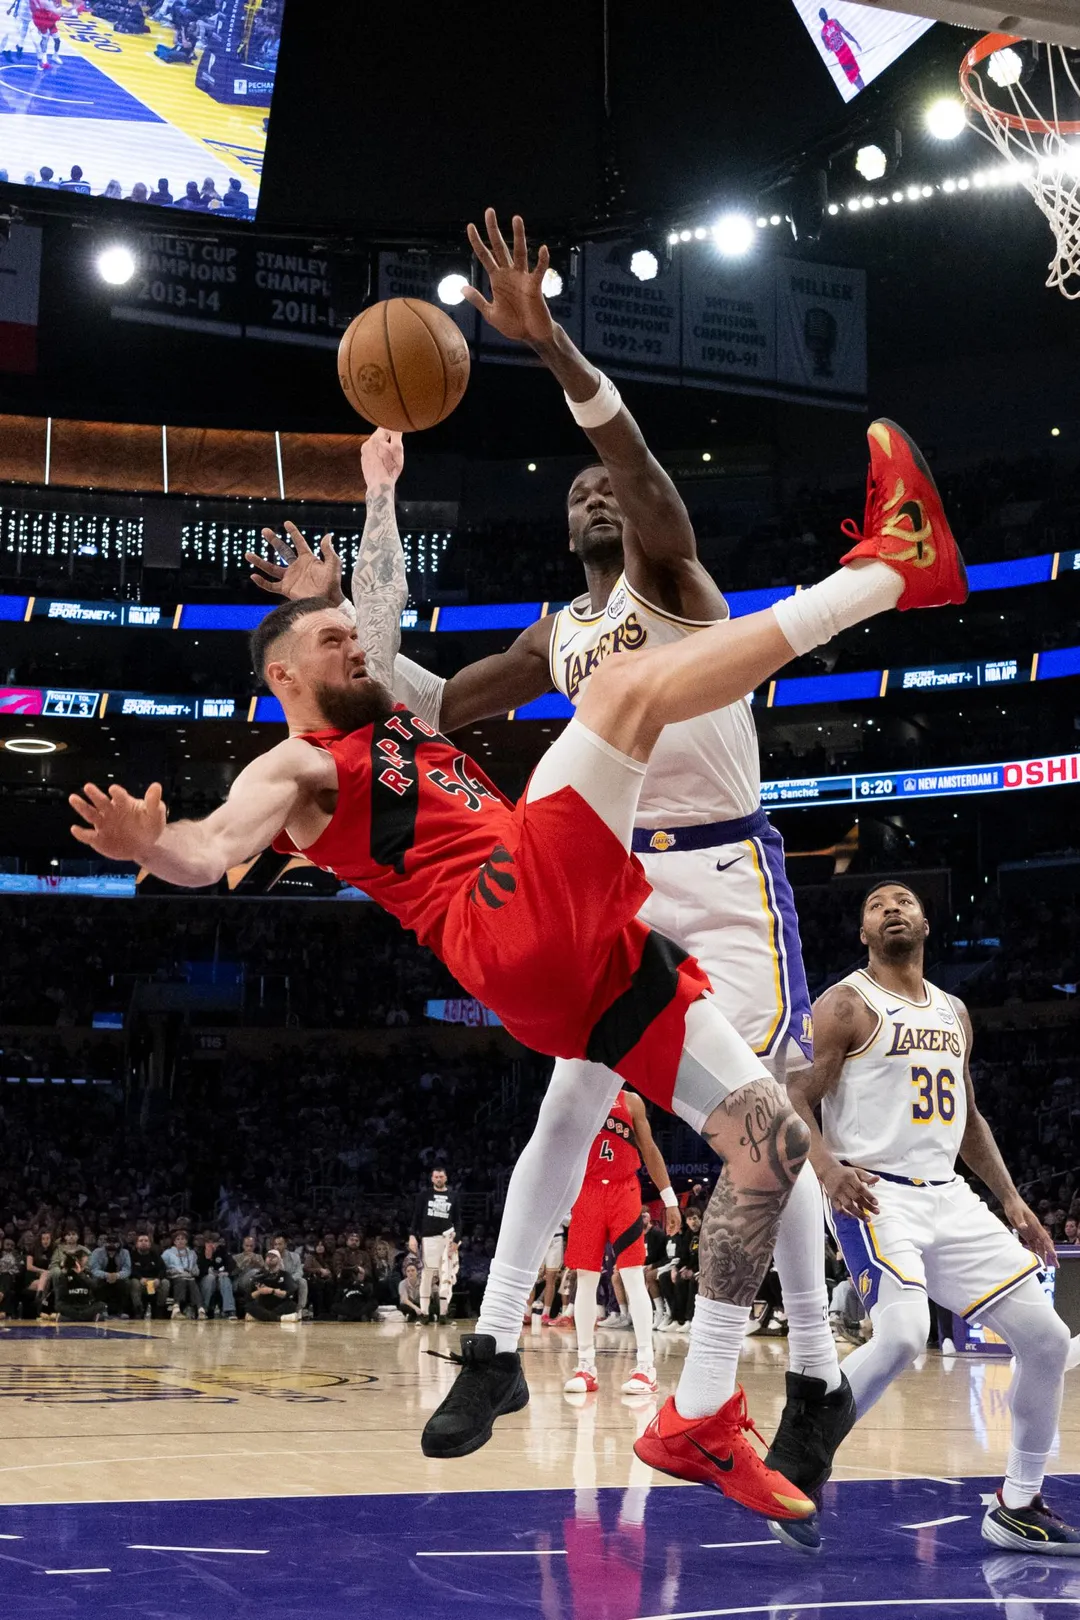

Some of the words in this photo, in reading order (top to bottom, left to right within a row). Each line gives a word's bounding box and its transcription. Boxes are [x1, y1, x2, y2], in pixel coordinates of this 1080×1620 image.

[201, 245, 239, 263] CUP
[256, 251, 328, 276] STANLEY
[147, 253, 237, 283] AMPIONS
[255, 270, 331, 297] CHAMPI
[599, 280, 666, 302] CAMPBELL
[138, 279, 221, 312] 2013-14
[591, 294, 675, 319] CONFERENCE
[272, 299, 335, 328] 2011-1
[595, 311, 671, 334] CHAMPIONS
[702, 311, 758, 330] DIVISION
[602, 332, 663, 355] 1992-93
[693, 325, 767, 348] CHAMPIONS
[701, 345, 758, 367] 1990-91
[48, 608, 118, 621] SPORTSNET+
[129, 611, 145, 624] NBA
[145, 611, 161, 625] APP
[902, 672, 973, 689] SPORTSNET+
[985, 667, 1001, 682] NBA
[1002, 665, 1017, 680] APP
[54, 700, 65, 715] 4
[79, 702, 89, 716] 3
[122, 704, 192, 716] SPORTSNET+
[203, 704, 219, 717] NBA
[219, 704, 235, 718] APP
[377, 716, 437, 796] RAPTO
[861, 779, 893, 796] 8:20
[918, 777, 937, 790] NEW
[938, 773, 992, 789] AMSTERDAM
[760, 792, 779, 800] rcos
[781, 788, 820, 799] Sanchez
[885, 1022, 962, 1058] LAKERS
[910, 1065, 958, 1126] 36
[599, 1139, 615, 1162] 4
